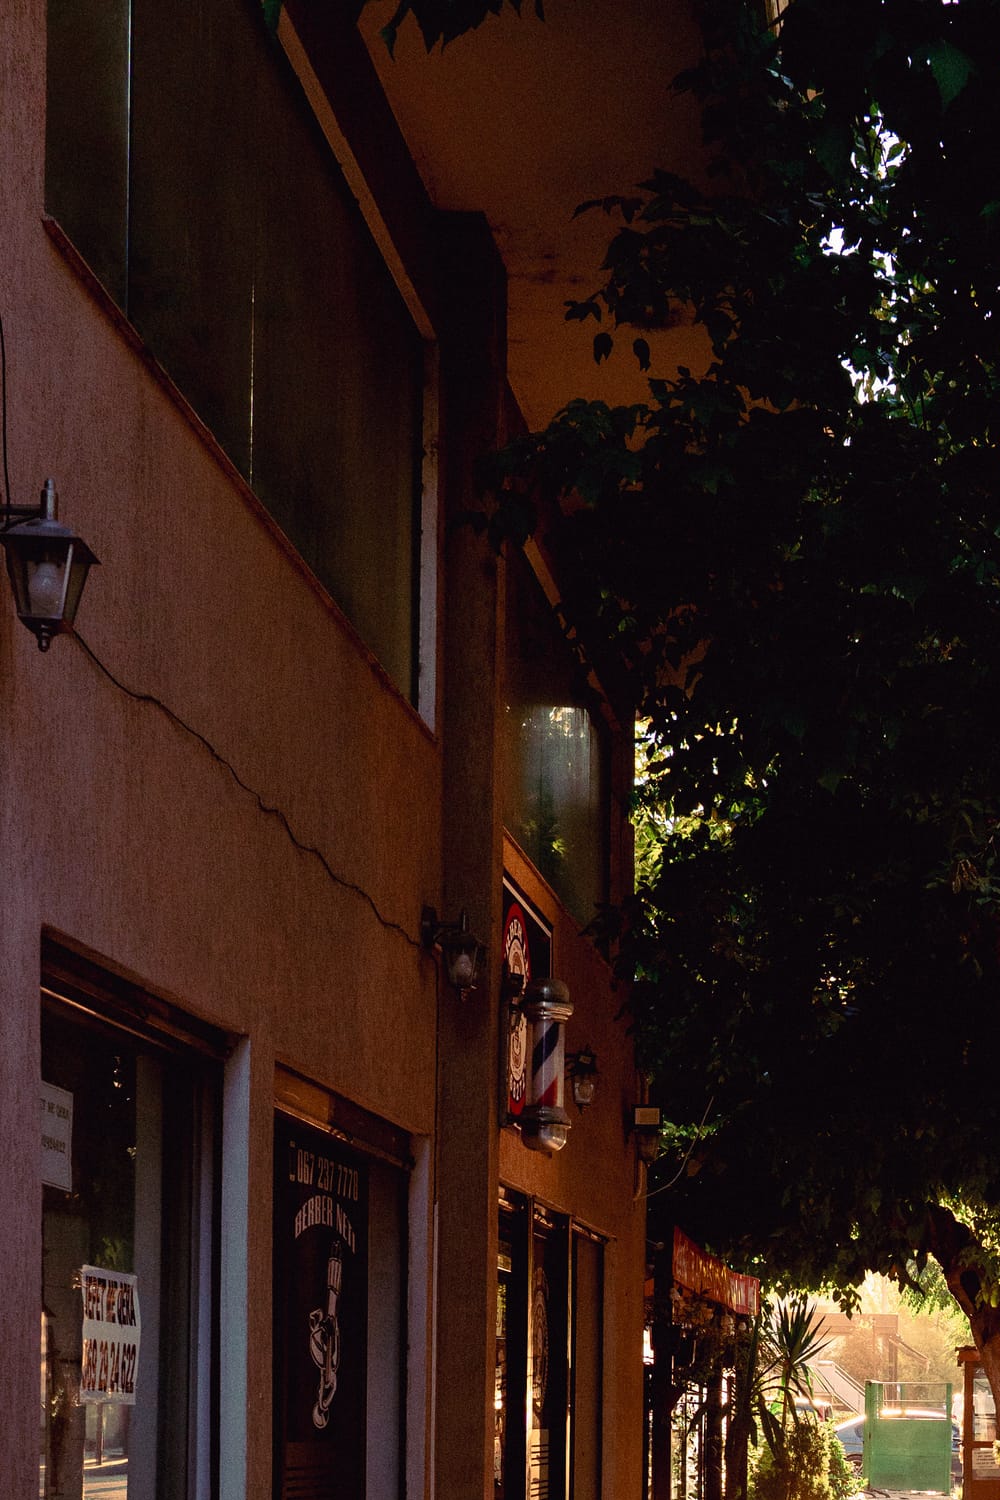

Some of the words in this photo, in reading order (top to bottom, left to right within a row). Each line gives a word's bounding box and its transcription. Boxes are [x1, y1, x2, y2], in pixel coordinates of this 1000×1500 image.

[297, 1149, 316, 1185] 067
[317, 1156, 335, 1192] 237
[294, 1194, 333, 1240] BERBER
[117, 1281, 137, 1328] QERA
[109, 1342, 120, 1393] 24
[120, 1343, 137, 1394] 622
